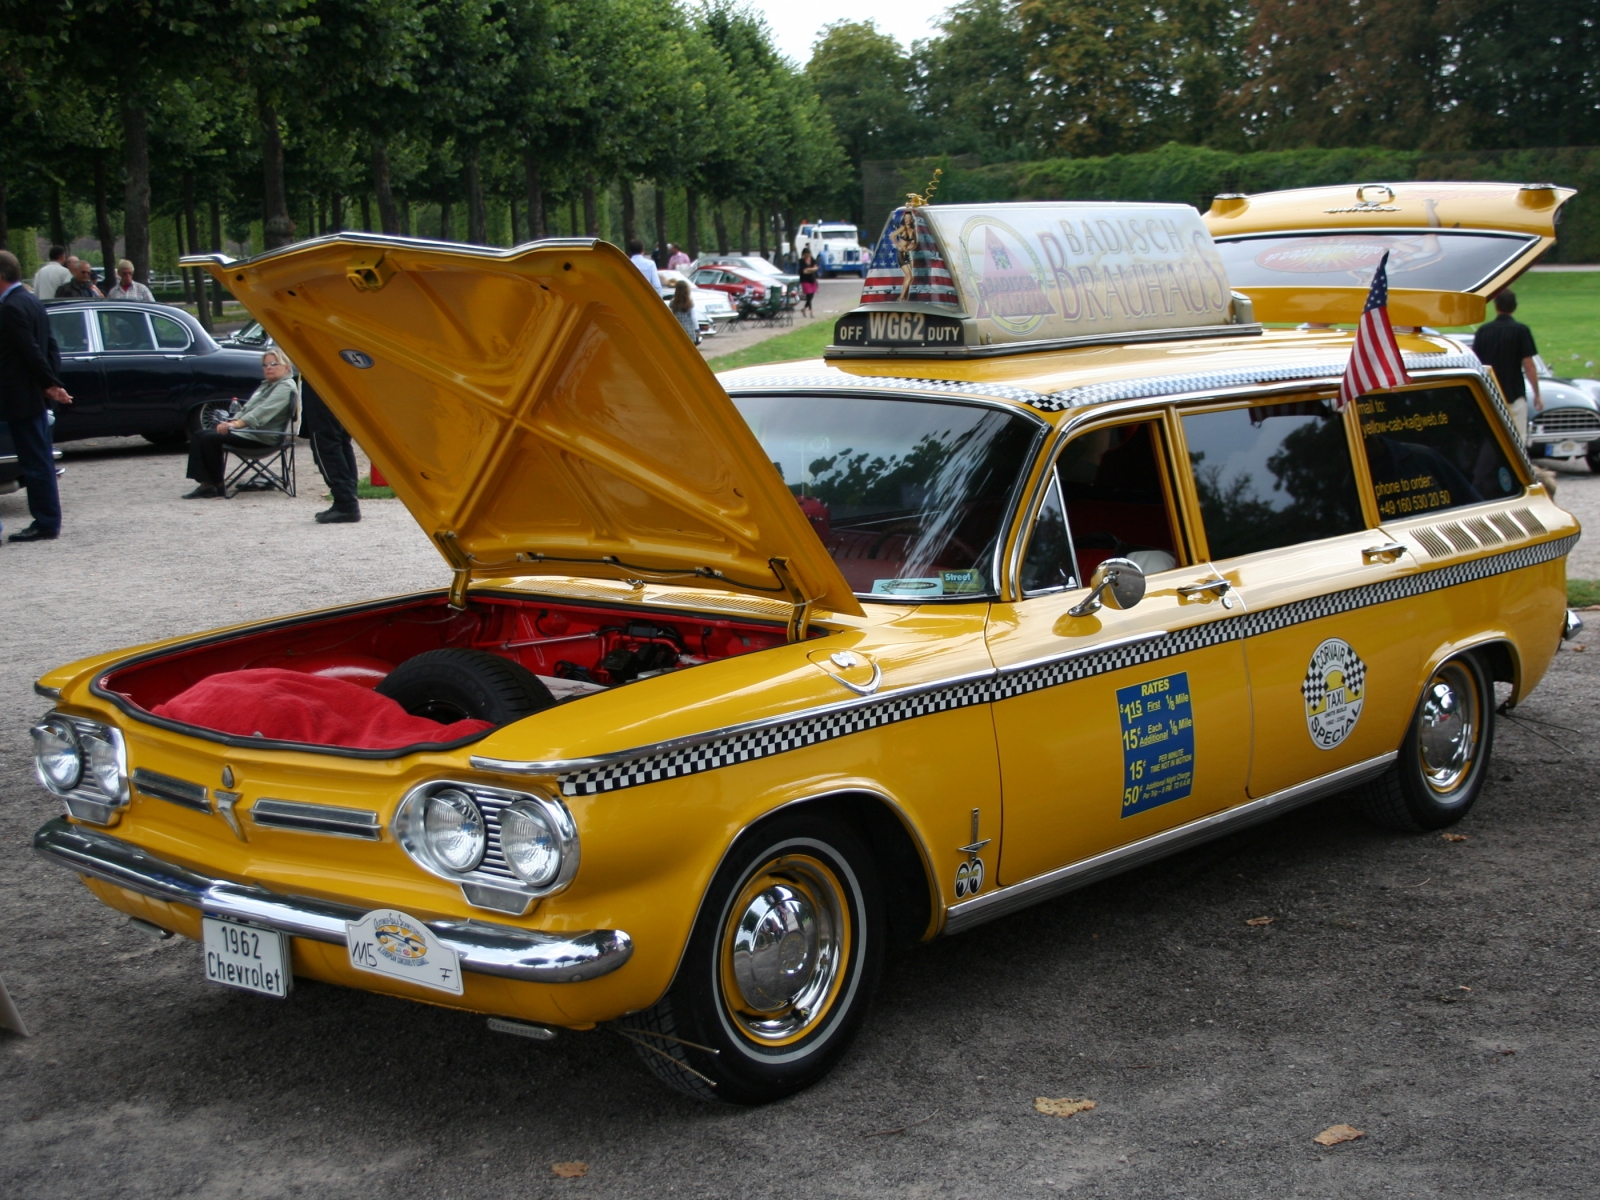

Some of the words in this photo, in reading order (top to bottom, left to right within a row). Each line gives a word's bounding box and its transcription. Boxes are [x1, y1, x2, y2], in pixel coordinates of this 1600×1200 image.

[1059, 219, 1186, 255] BADISCH
[1036, 230, 1226, 320] BRAUHAUS
[840, 326, 863, 340] OFF
[869, 312, 925, 340] WG62
[927, 326, 960, 341] DUTY
[1357, 399, 1374, 414] mail
[1375, 399, 1387, 412] to:
[1362, 411, 1449, 438] yellow-cab-ka@web.de
[1375, 481, 1400, 499] phone
[1401, 478, 1410, 491] to
[1410, 474, 1434, 489] order:
[1380, 500, 1396, 515] +49
[1397, 497, 1412, 513] 160
[1412, 493, 1428, 510] 530
[1428, 492, 1439, 507] 20
[1439, 490, 1451, 505] 50
[944, 573, 972, 581] Street
[1316, 644, 1346, 670] CORVAIR
[1141, 679, 1170, 697] RATES
[1326, 689, 1344, 709] TAXI
[1147, 700, 1161, 712] First
[1175, 693, 1189, 705] Mile
[1147, 722, 1163, 734] Each
[1178, 717, 1192, 730] Mile
[1311, 703, 1361, 745] SPECIAL
[1140, 729, 1169, 747] Additional
[222, 925, 262, 960] 1962
[208, 951, 280, 993] Chevrolet
